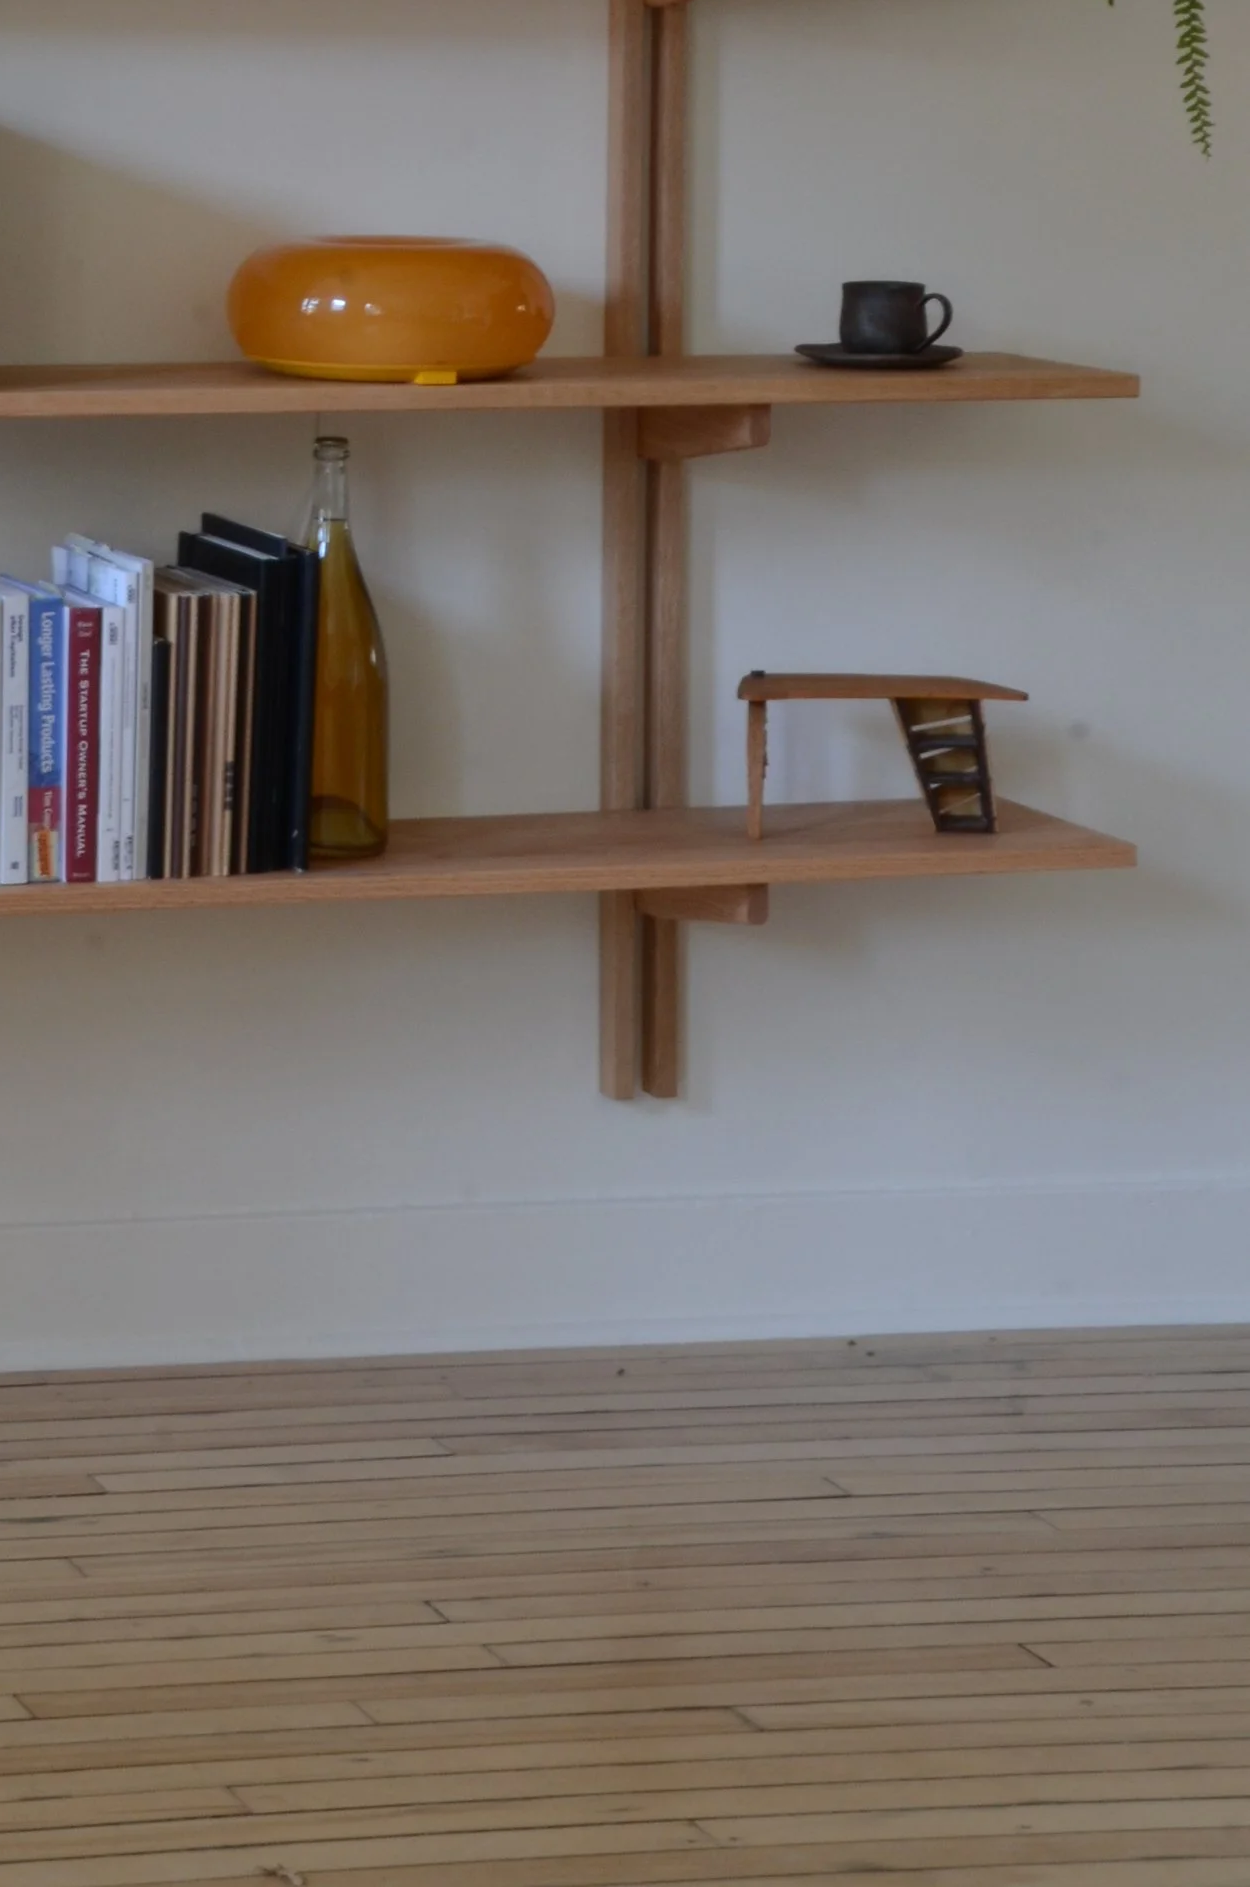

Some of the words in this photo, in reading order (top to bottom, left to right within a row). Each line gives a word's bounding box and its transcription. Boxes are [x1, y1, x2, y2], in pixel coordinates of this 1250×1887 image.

[37, 611, 57, 658] Longer
[79, 649, 91, 675] THE
[37, 661, 57, 712] Lasting
[77, 679, 91, 737] STARTUP
[40, 714, 56, 773] Products
[77, 740, 90, 800] OWNER'S
[76, 804, 89, 859] MANUAL
